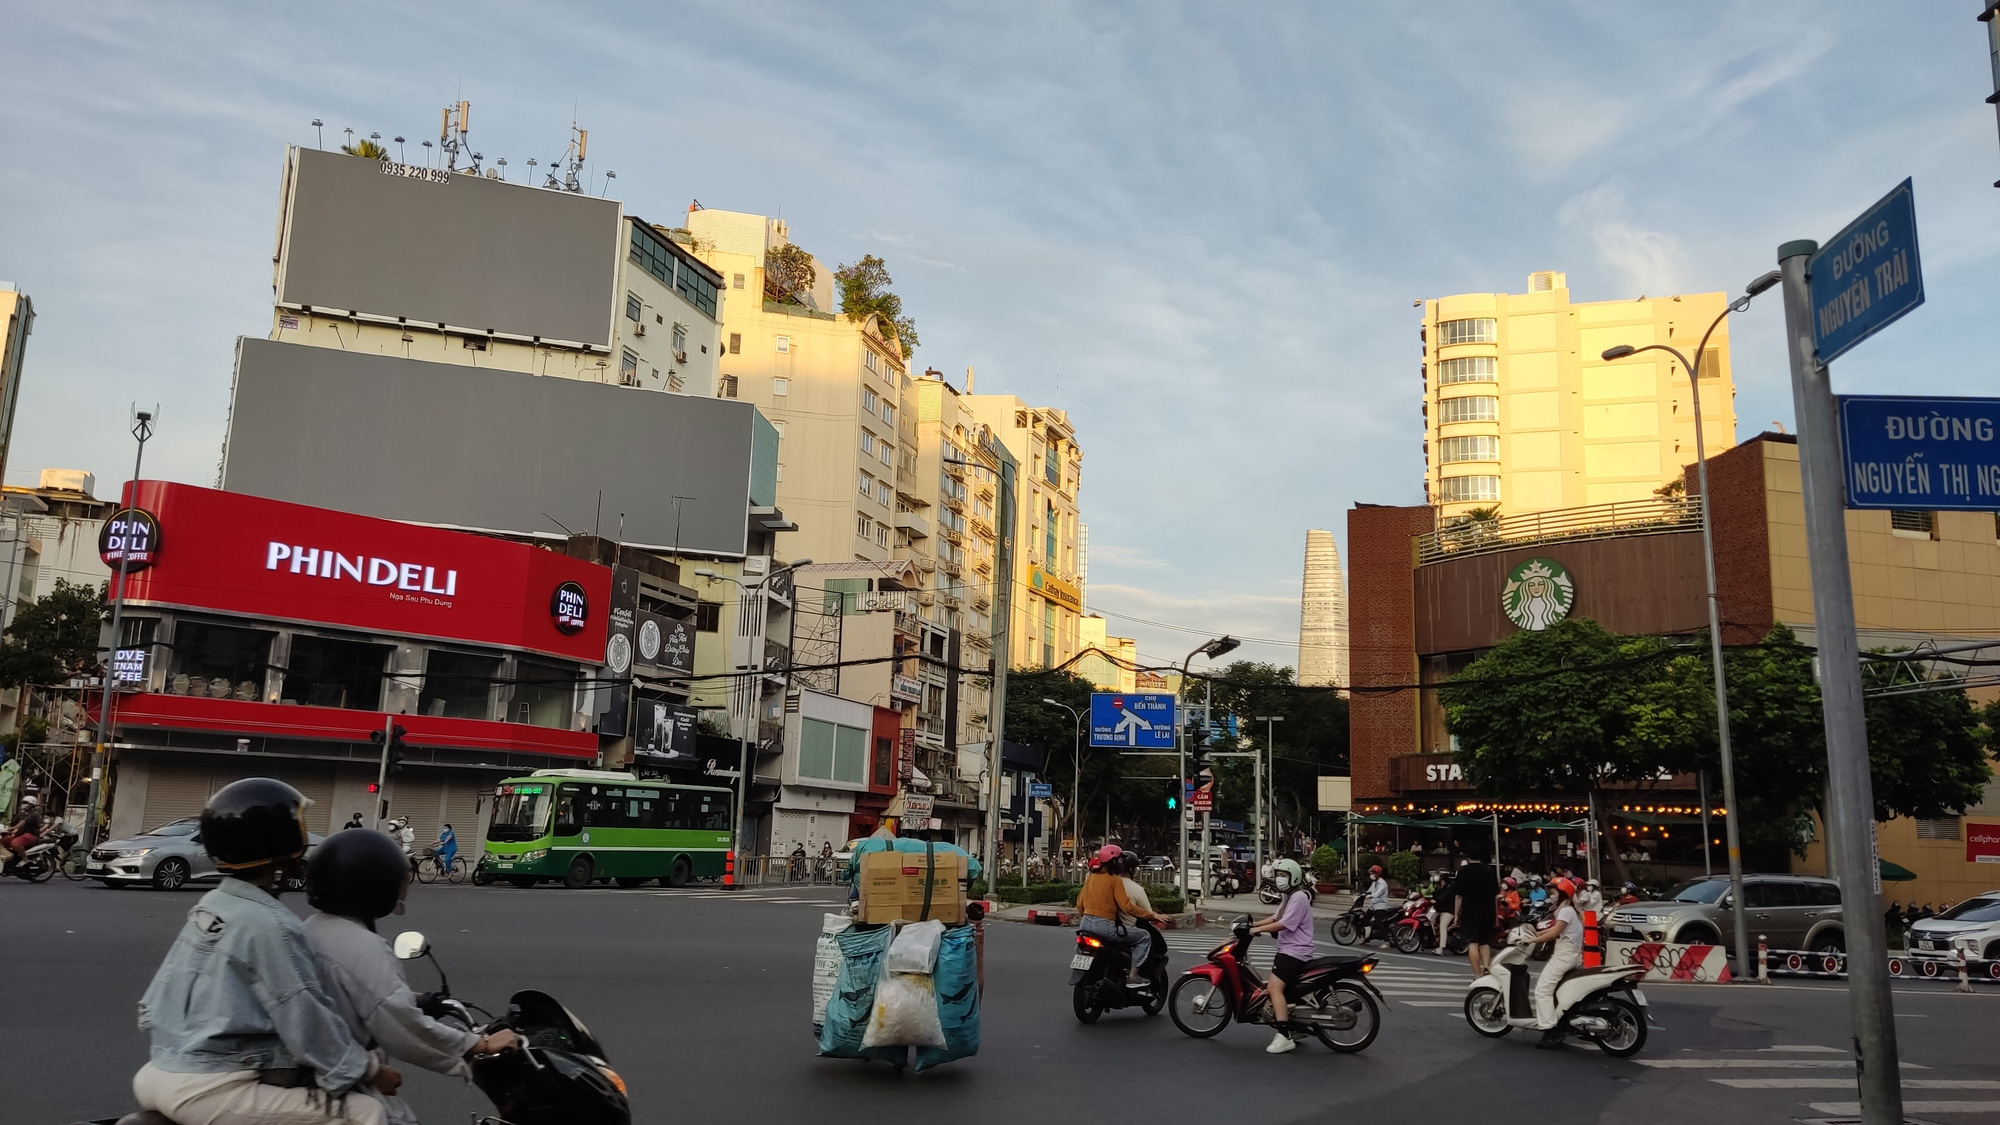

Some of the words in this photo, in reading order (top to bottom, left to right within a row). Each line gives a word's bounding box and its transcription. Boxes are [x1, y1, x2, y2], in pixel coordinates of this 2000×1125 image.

[380, 161, 405, 176] 0935
[409, 166, 427, 180] 220
[431, 169, 449, 184] 999
[1832, 220, 1889, 280] ĐƯỜNG
[1885, 410, 1994, 441] ĐƯỜNG
[1854, 452, 1931, 494] NGUYỄN
[1939, 464, 1971, 501] THỊ
[107, 551, 123, 560] FINE
[266, 541, 457, 596] PHINDELI
[560, 589, 584, 605] PHIN
[1046, 581, 1059, 599] Cathay
[559, 602, 582, 618] DELI
[113, 662, 143, 671] TNAM
[1134, 701, 1146, 710] BẾN
[1147, 701, 1167, 710] THÀNH
[1162, 731, 1170, 739] LAI
